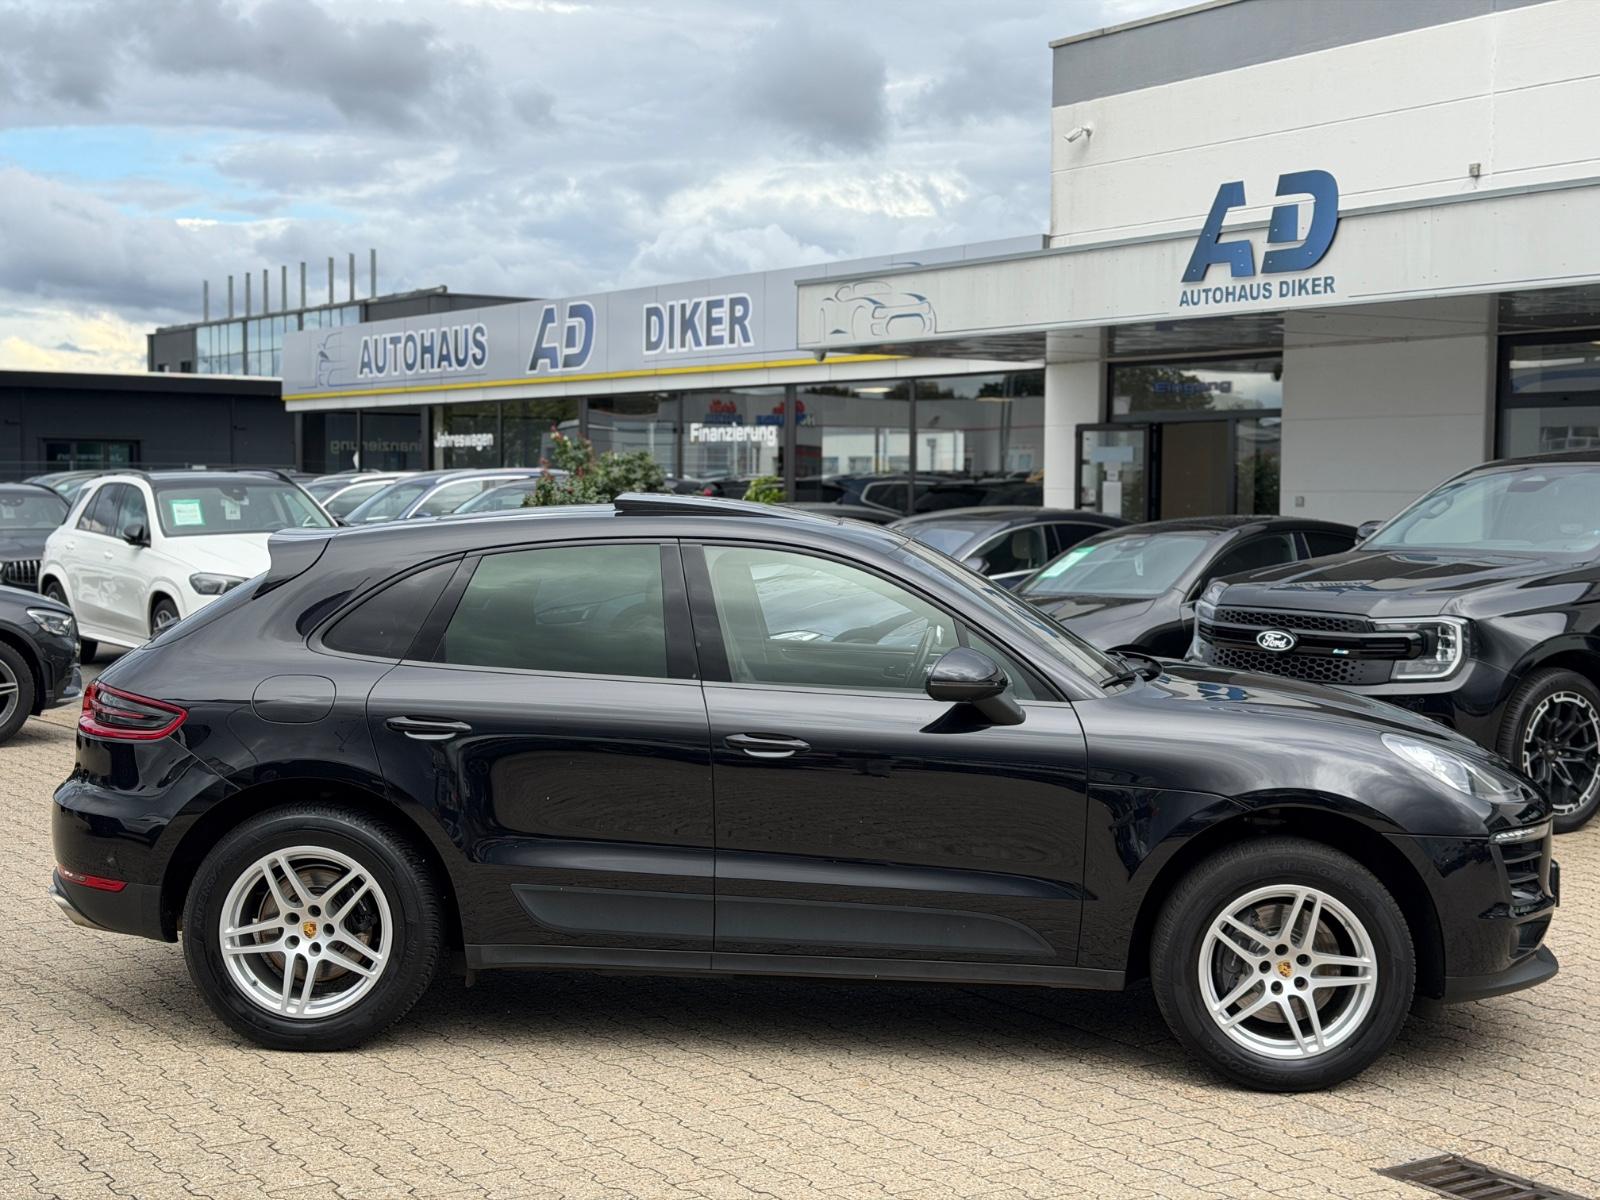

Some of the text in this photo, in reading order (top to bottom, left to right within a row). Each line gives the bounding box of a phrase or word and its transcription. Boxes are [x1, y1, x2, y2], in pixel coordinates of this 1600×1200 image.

[1181, 169, 1340, 283] AD
[1180, 276, 1336, 307] AUTOHAUS DIKER
[359, 293, 755, 379] AUTOHAUS AD DIKER
[433, 431, 494, 452] Jahreswagen
[689, 421, 777, 447] Finanzierung
[1262, 632, 1287, 649] Ford
